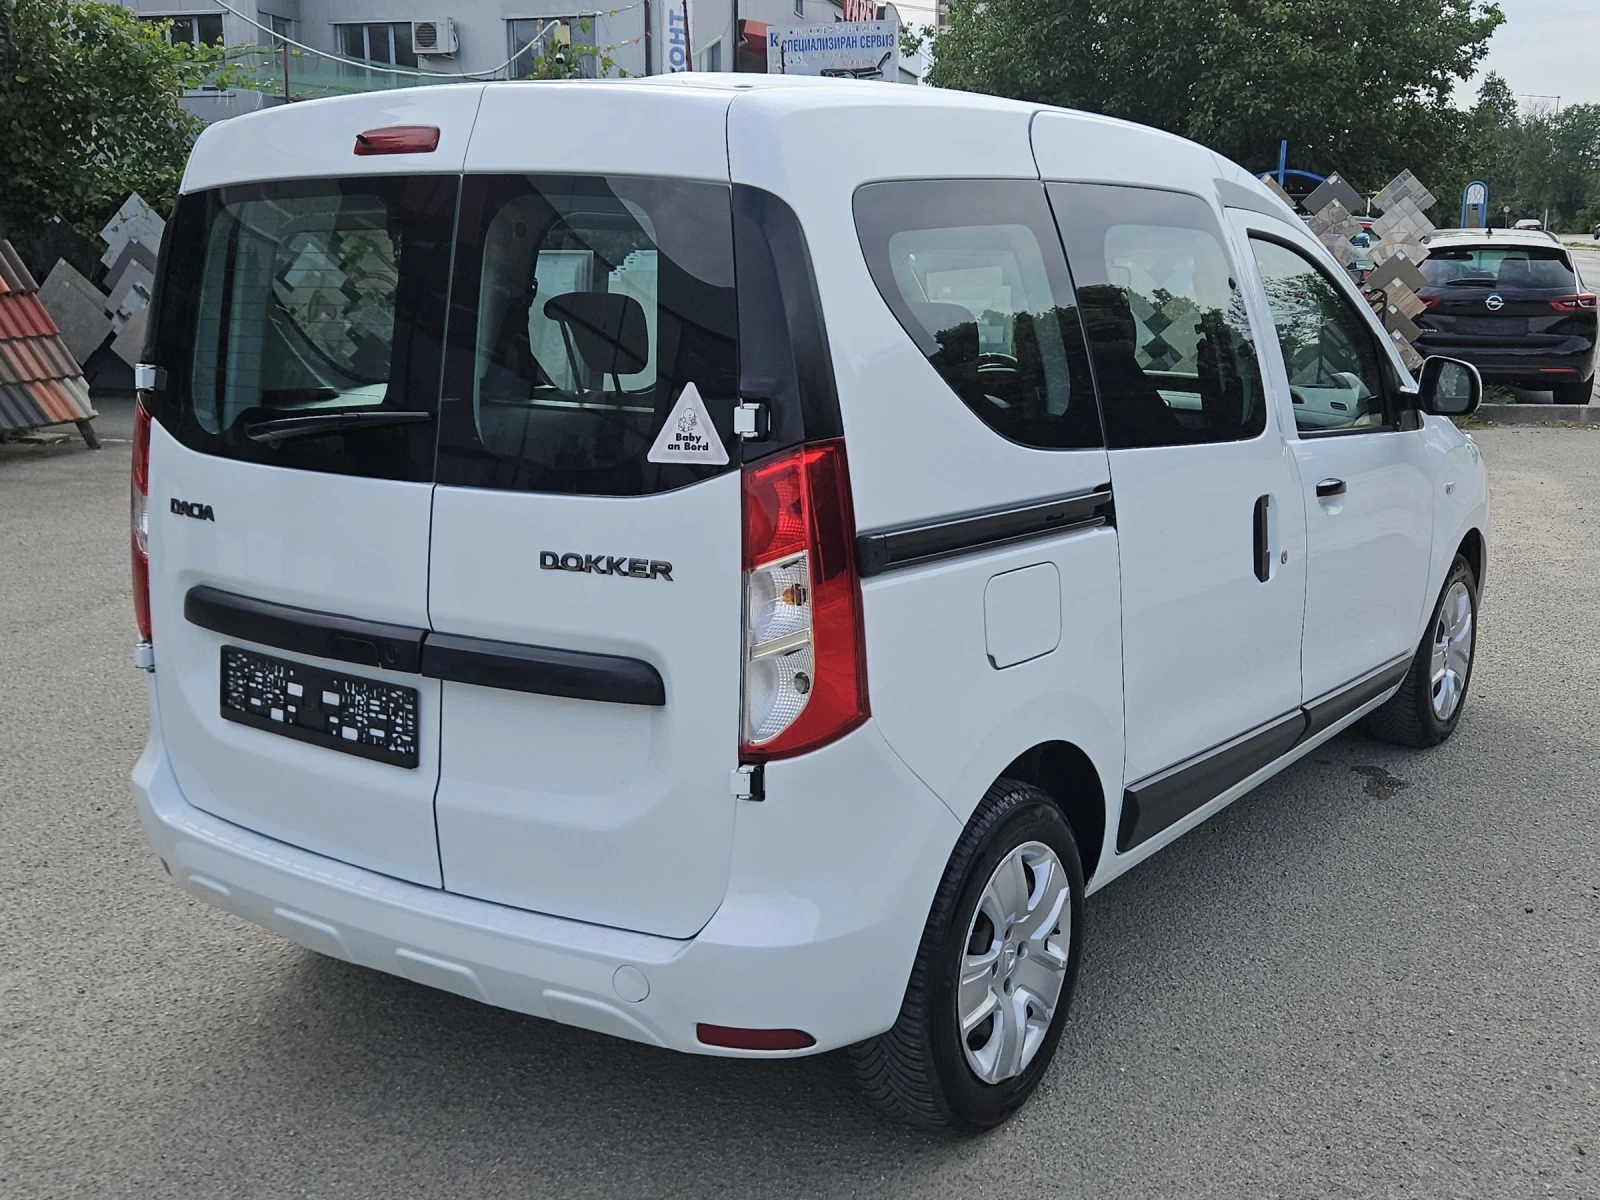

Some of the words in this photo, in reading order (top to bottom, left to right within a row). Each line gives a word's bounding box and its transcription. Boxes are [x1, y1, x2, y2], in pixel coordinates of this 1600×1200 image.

[782, 36, 858, 53] СПЕЦИАЛИЗИРАН
[860, 34, 895, 48] СЕРВИЗ
[667, 443, 680, 451] an
[684, 442, 709, 451] Bord
[675, 433, 702, 443] Baby
[170, 498, 215, 522] DACIA
[540, 551, 674, 581] DOKKER
